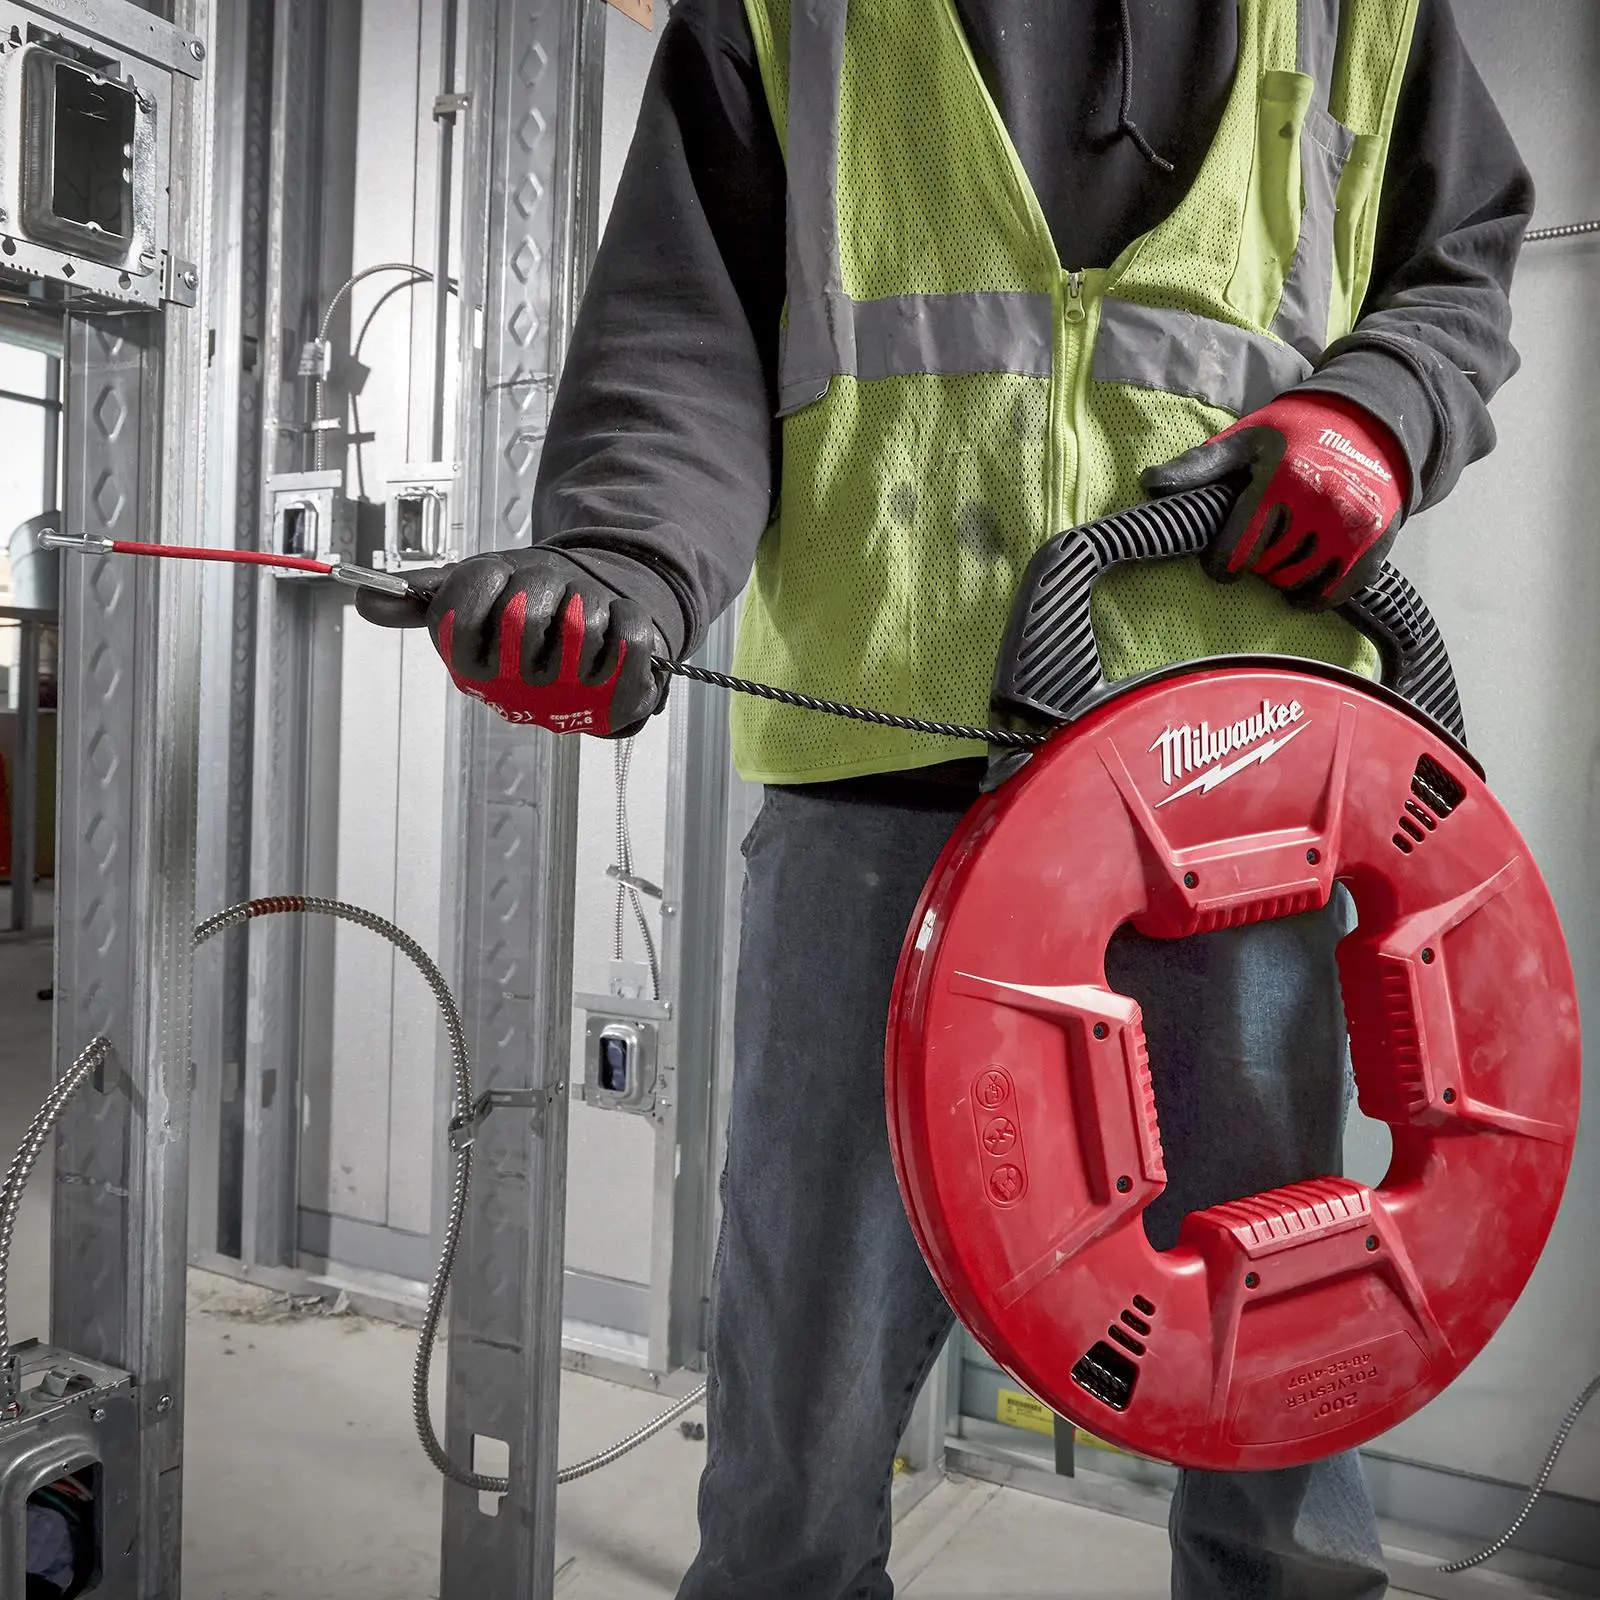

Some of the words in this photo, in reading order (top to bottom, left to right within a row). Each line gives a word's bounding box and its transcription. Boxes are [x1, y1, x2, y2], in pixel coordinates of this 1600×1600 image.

[1318, 428, 1392, 482] Milwaukee
[1148, 699, 1305, 785] Milwaukee
[1285, 1365, 1378, 1409] POLYESTER
[1287, 1353, 1371, 1390] 48-22-4197
